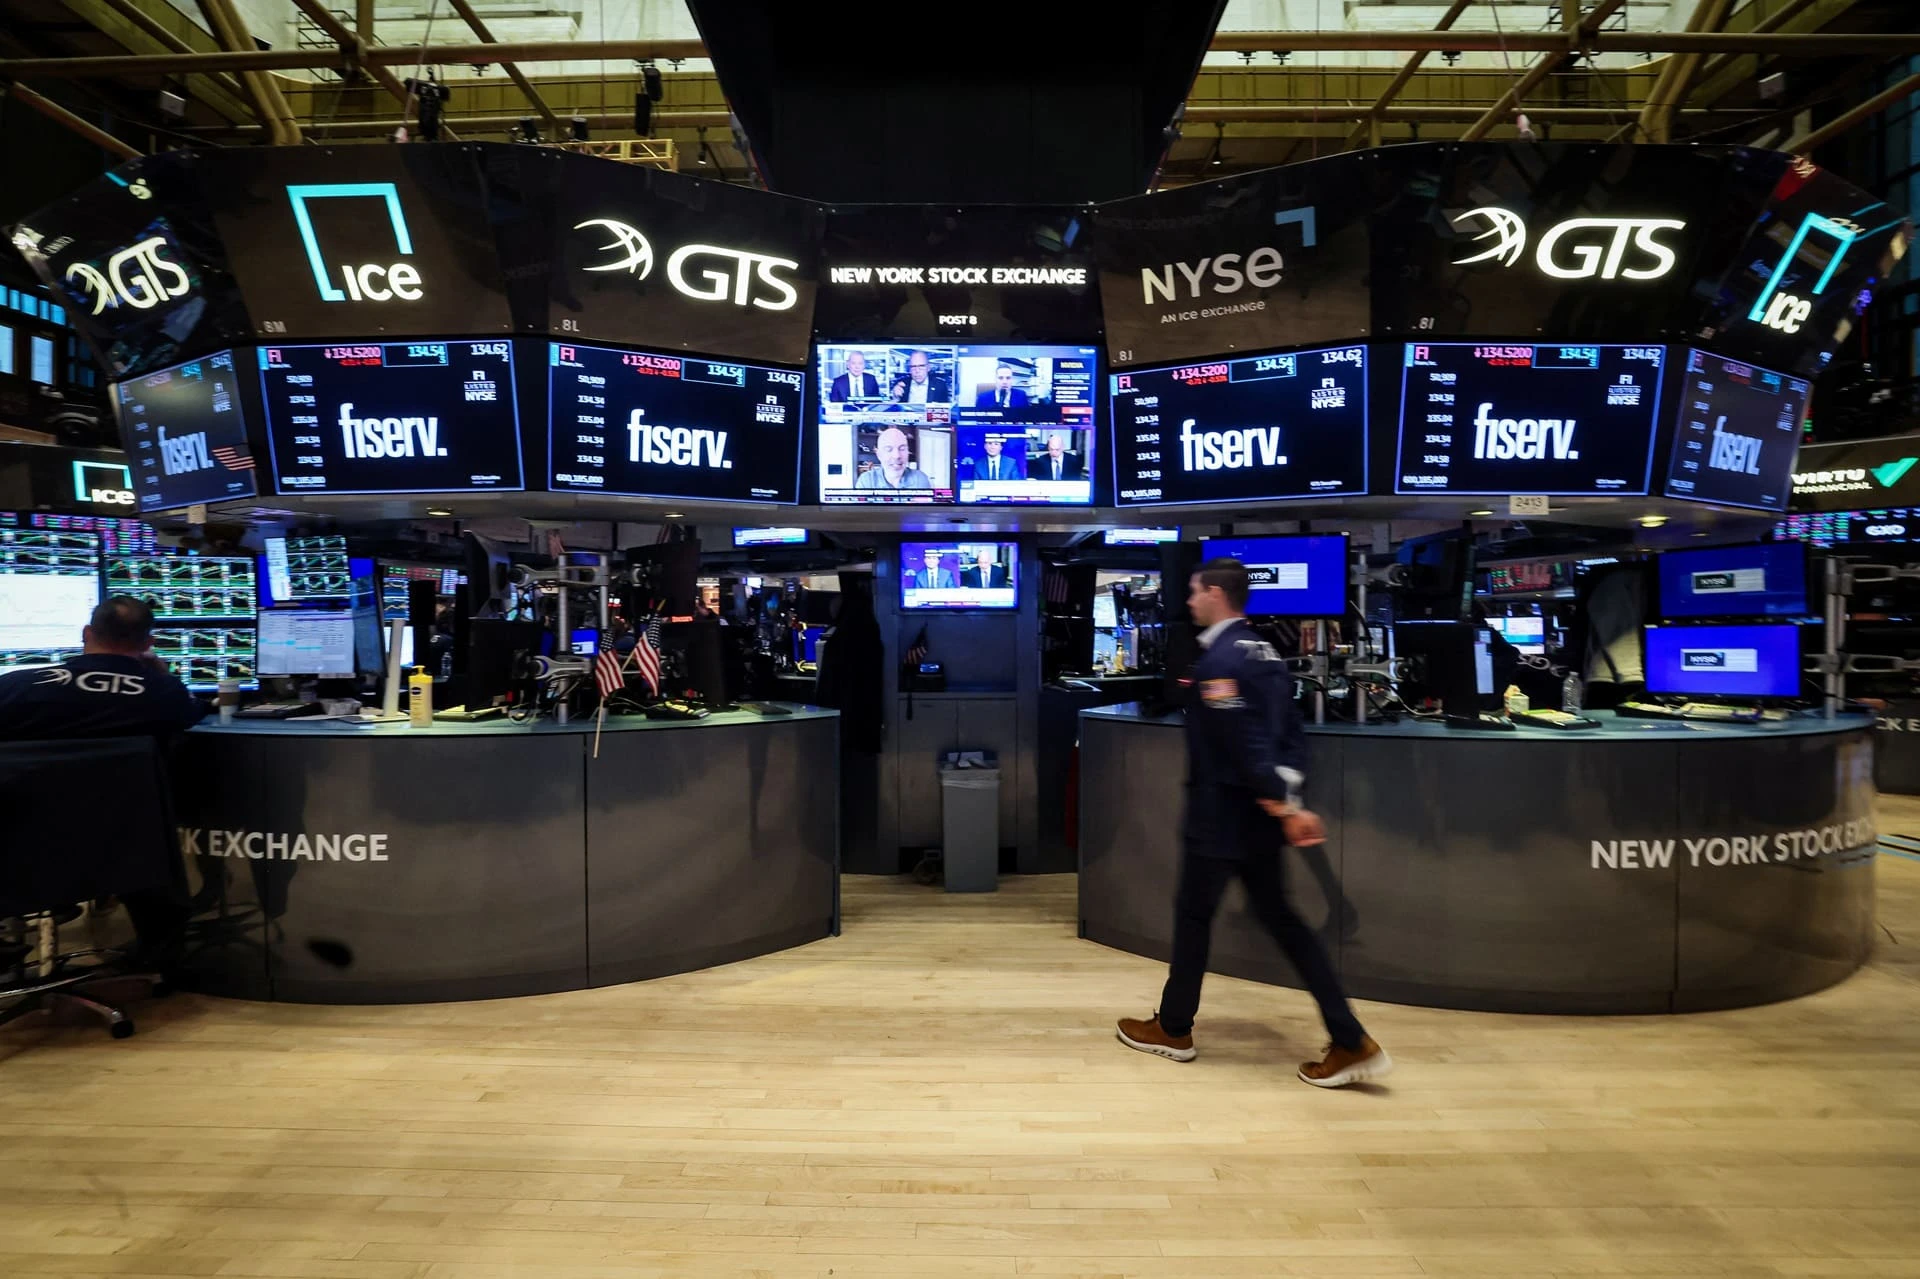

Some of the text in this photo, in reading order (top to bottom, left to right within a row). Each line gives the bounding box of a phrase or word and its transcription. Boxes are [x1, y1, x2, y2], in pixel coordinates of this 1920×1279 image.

[1535, 218, 1685, 280] GTS
[109, 237, 189, 308] GTS
[667, 244, 798, 311] GTS
[831, 268, 1086, 284] NEW YORK STOCK EXCHANGE
[939, 316, 977, 325] POST 8
[1161, 314, 1176, 323] AN
[563, 319, 580, 331] 8L
[1256, 356, 1294, 372] 134.54
[1321, 349, 1362, 364] 134.62
[708, 364, 744, 378] 134.54
[767, 372, 801, 384] 134.62
[465, 391, 497, 401] NYSE
[1312, 389, 1346, 398] LISTED
[1312, 397, 1345, 409] NYSE
[1607, 395, 1640, 405] NYSE
[756, 405, 786, 413] LISTED
[756, 412, 785, 424] NYSE
[1791, 468, 1866, 485] VIRTU
[1793, 482, 1872, 494] FINANCIAL
[1865, 524, 1905, 536] GXO
[76, 671, 145, 695] GTS
[209, 830, 388, 861] EXCHANGE
[1591, 840, 1675, 870] NEW
[1685, 835, 1769, 865] YORK
[1774, 824, 1843, 861] STOCK
